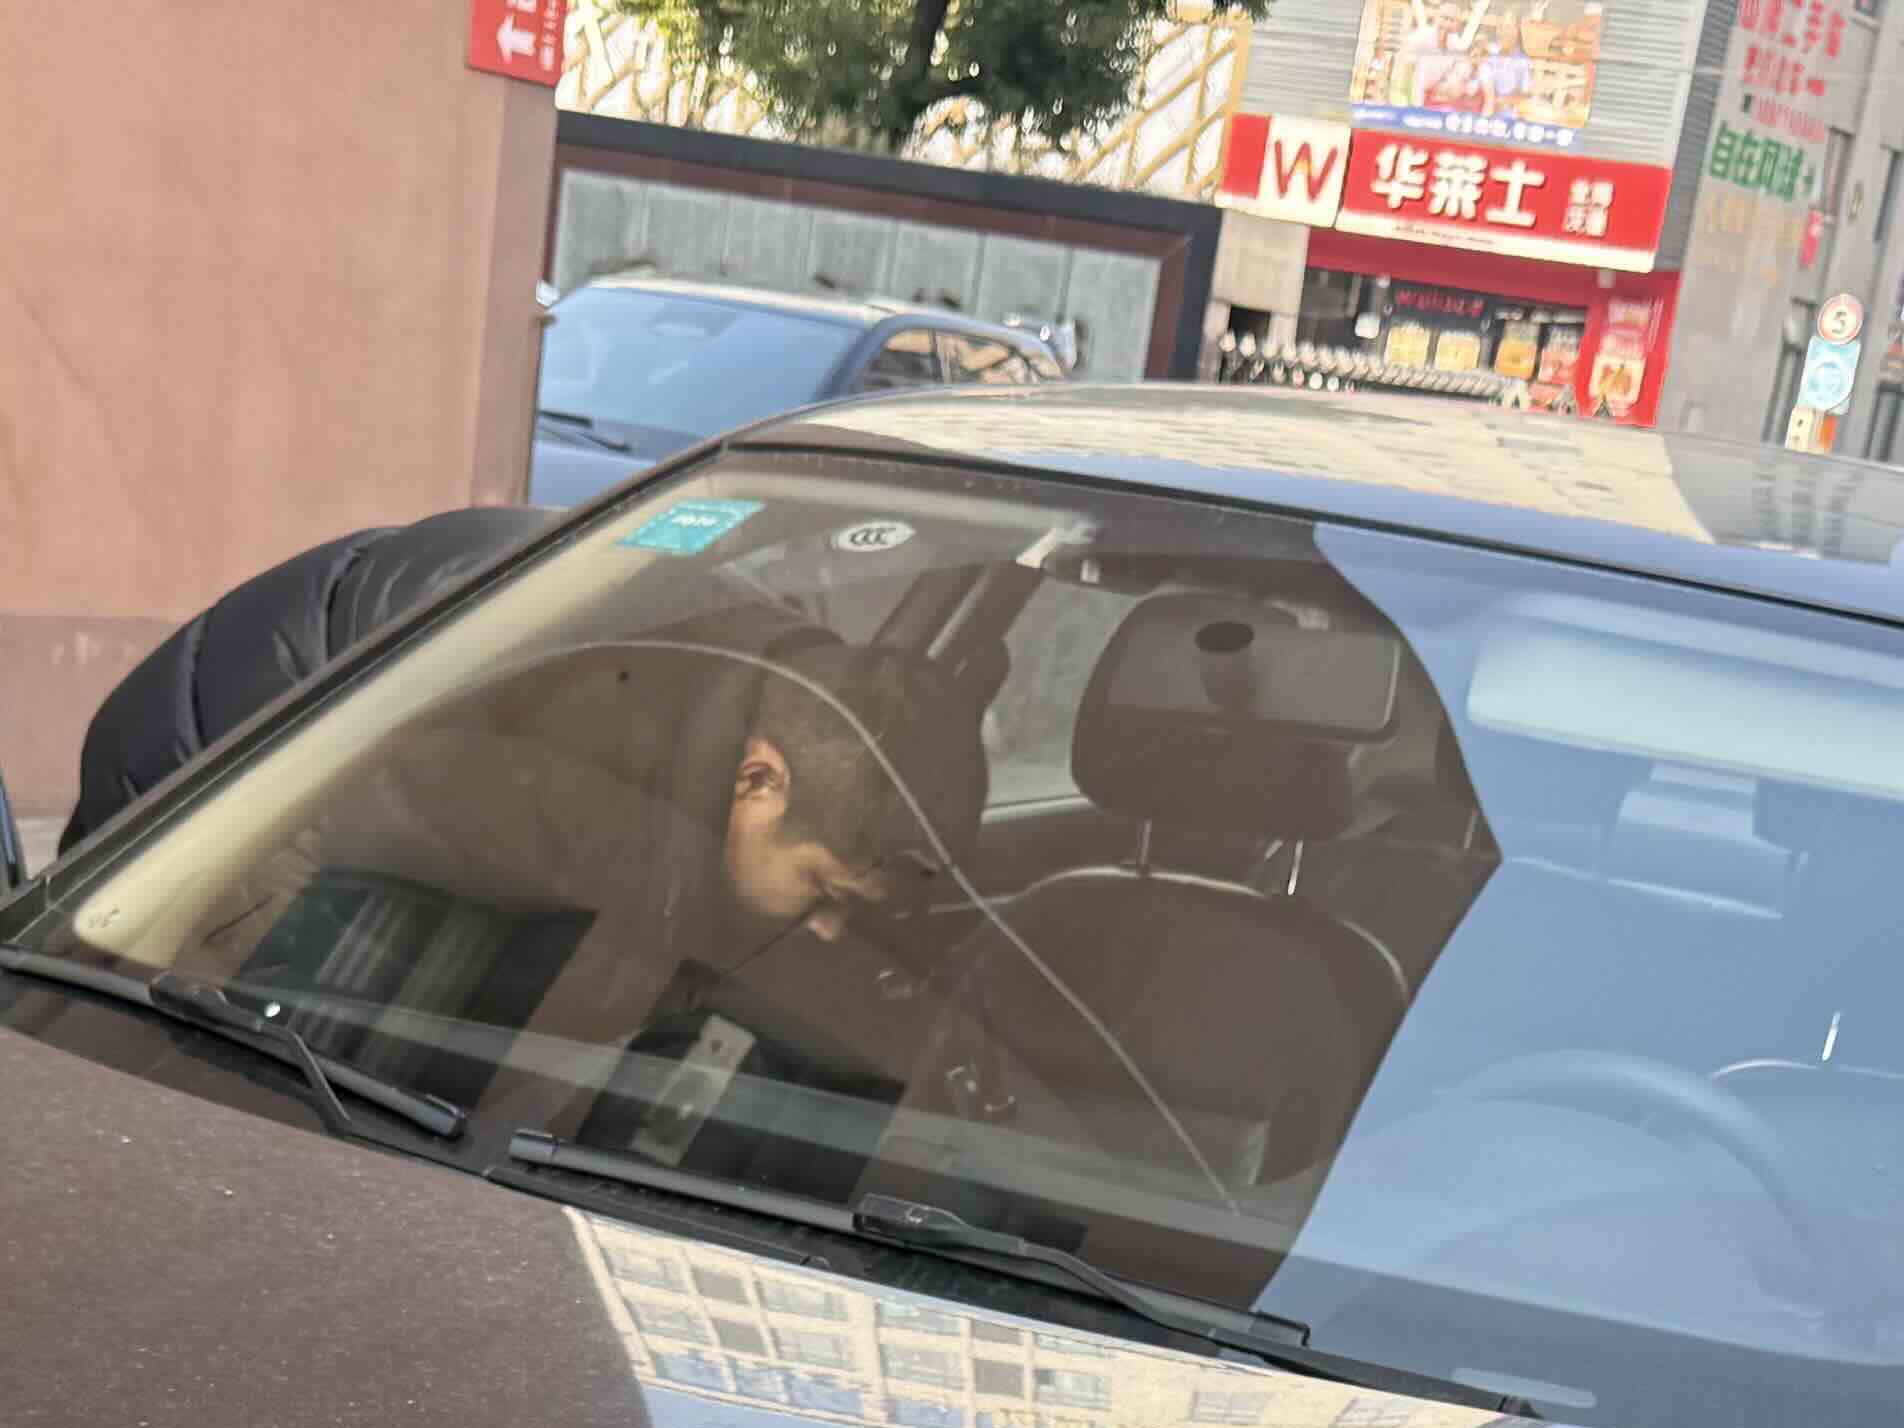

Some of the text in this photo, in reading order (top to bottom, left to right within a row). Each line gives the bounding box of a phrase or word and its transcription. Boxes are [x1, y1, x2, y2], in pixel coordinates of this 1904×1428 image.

[1371, 143, 1547, 229] 华莱士
[1831, 310, 1848, 334] 5
